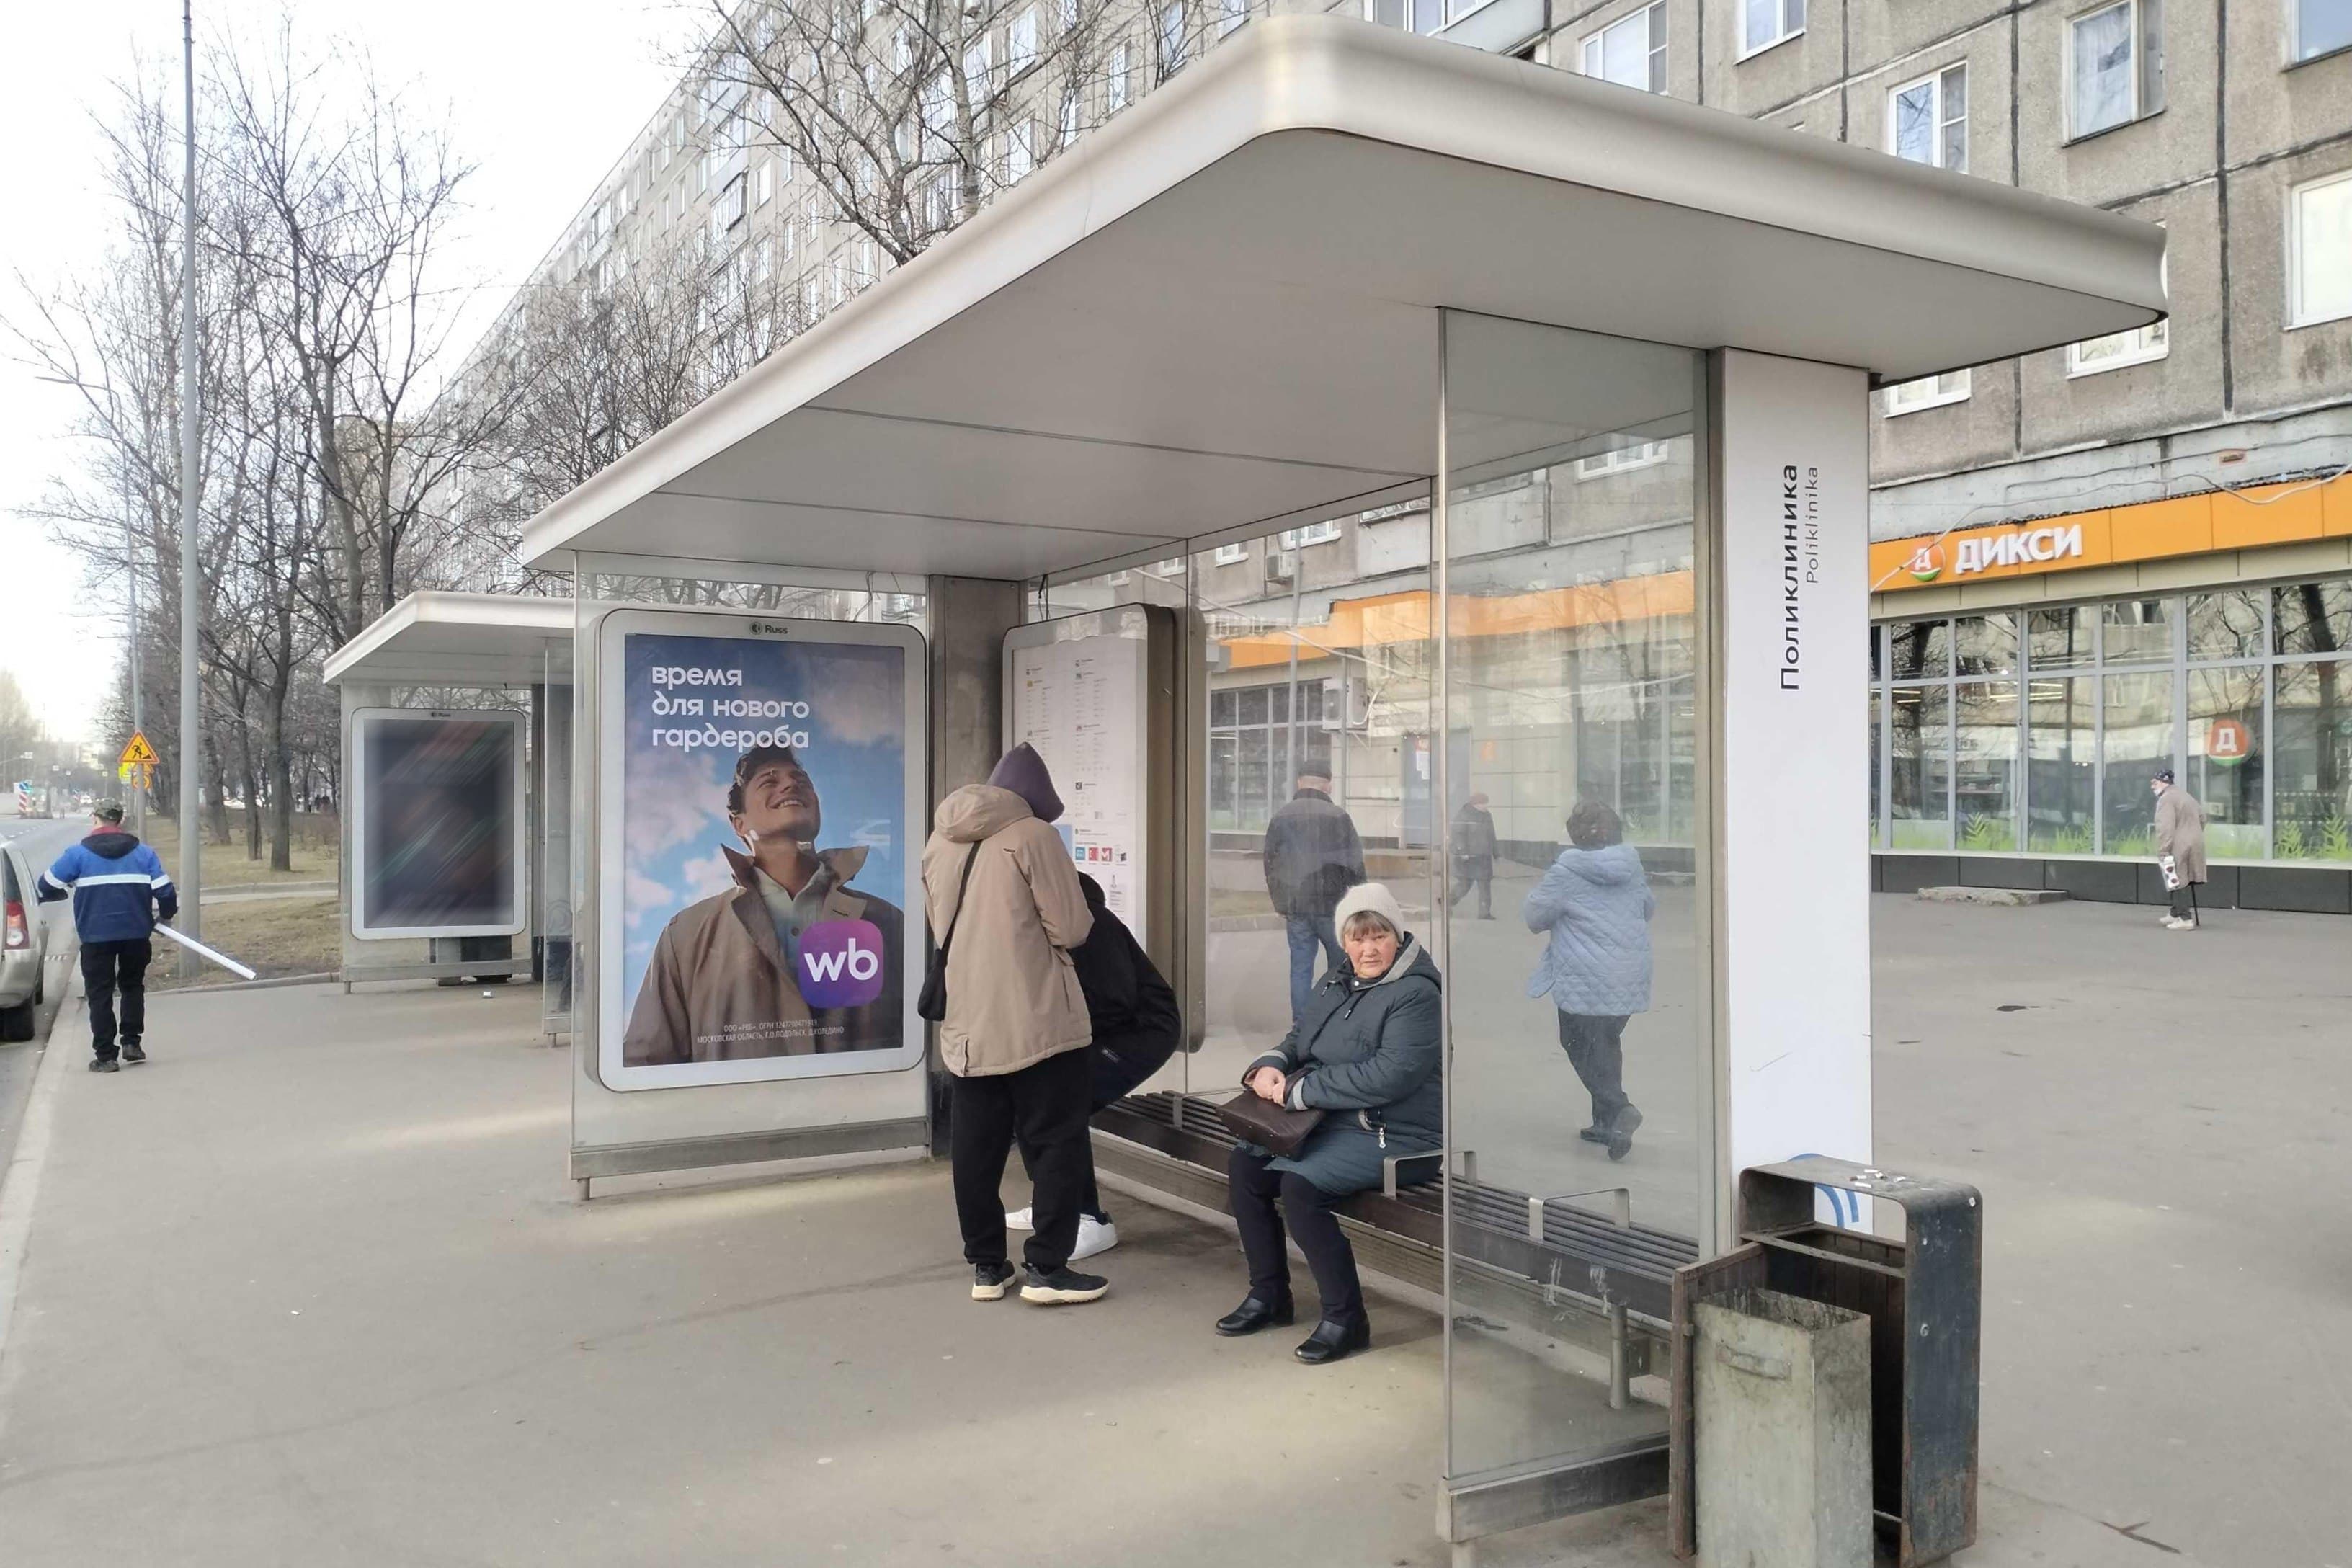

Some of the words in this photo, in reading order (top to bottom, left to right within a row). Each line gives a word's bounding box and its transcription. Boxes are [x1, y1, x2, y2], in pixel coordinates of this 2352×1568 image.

[1805, 466, 1819, 583] Poliklinika
[1955, 524, 2082, 574] ДИКСИ
[1781, 465, 1799, 690] Поликлиника
[765, 624, 788, 634] Russ
[651, 666, 743, 690] время
[651, 691, 704, 716] для
[713, 698, 810, 719] нового
[652, 723, 809, 753] гардероба
[2216, 727, 2237, 753] Д
[803, 937, 879, 982] wb
[697, 1033, 736, 1044] МОСКОВСКАЯ
[723, 1024, 737, 1033] ООО
[760, 1021, 774, 1030] ОГРН
